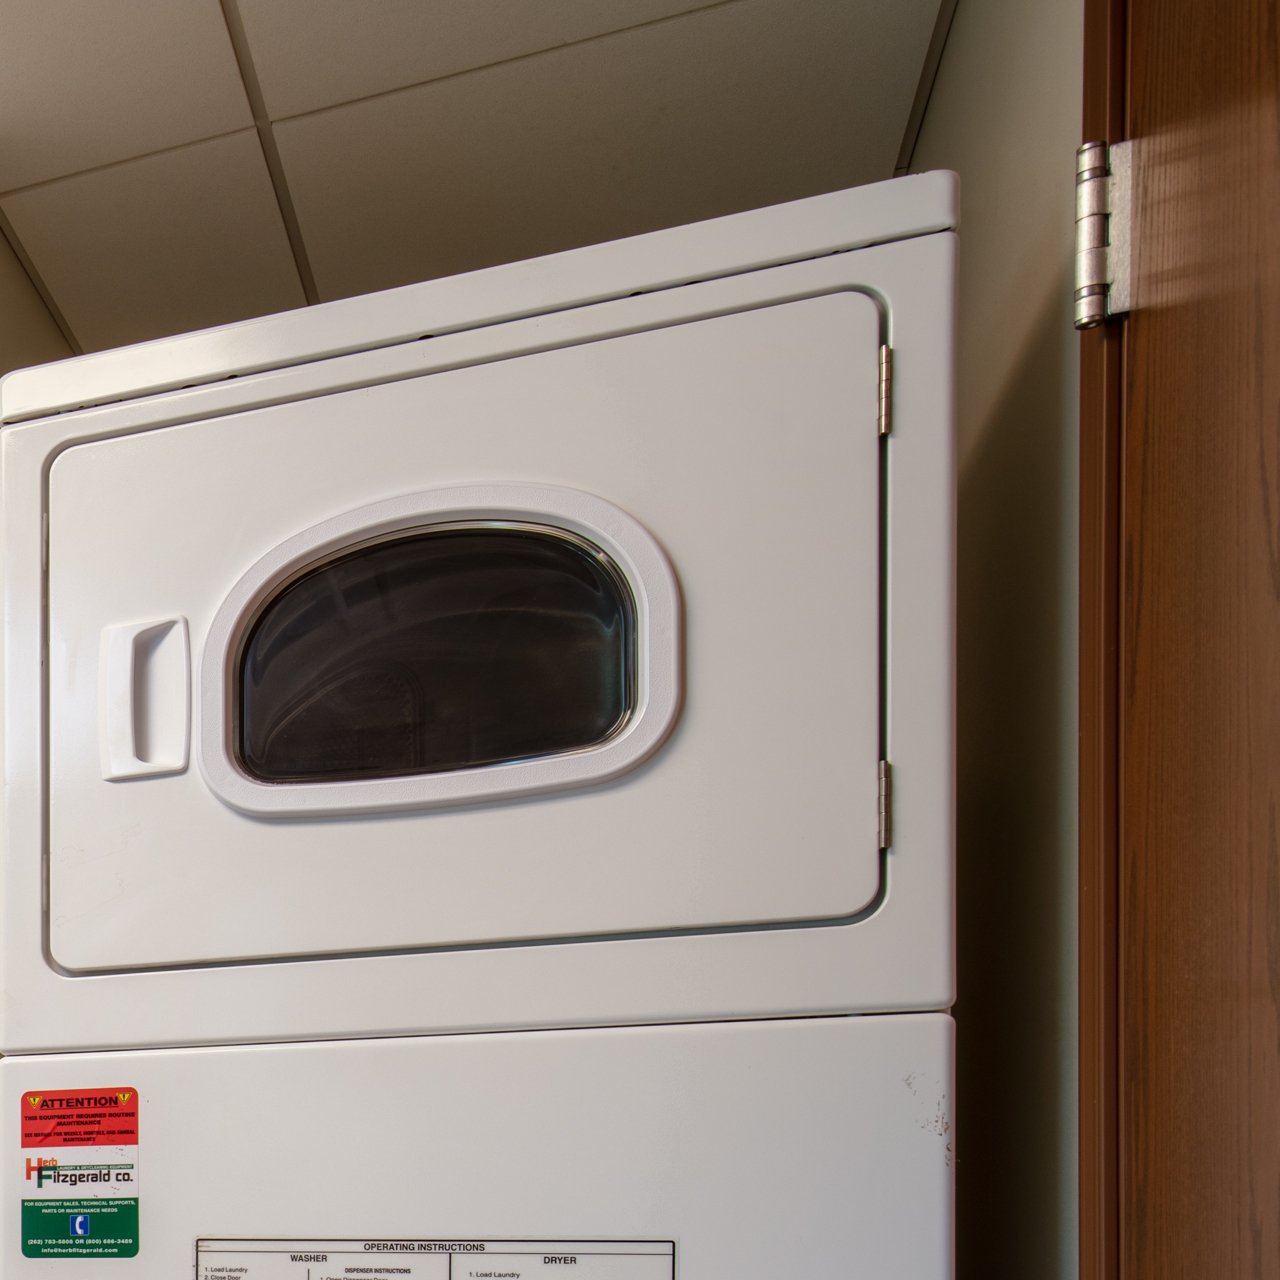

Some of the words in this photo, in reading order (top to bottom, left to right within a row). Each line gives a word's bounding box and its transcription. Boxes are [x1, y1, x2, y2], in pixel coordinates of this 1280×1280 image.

[40, 1097, 118, 1108] ATTENTION
[26, 1157, 57, 1180] Herb
[37, 1167, 110, 1188] Fitzgerald
[116, 1172, 133, 1182] co.
[418, 1244, 484, 1252] INSTRUCTIONS
[290, 1254, 327, 1262] WASHER
[543, 1256, 577, 1264] DRYER
